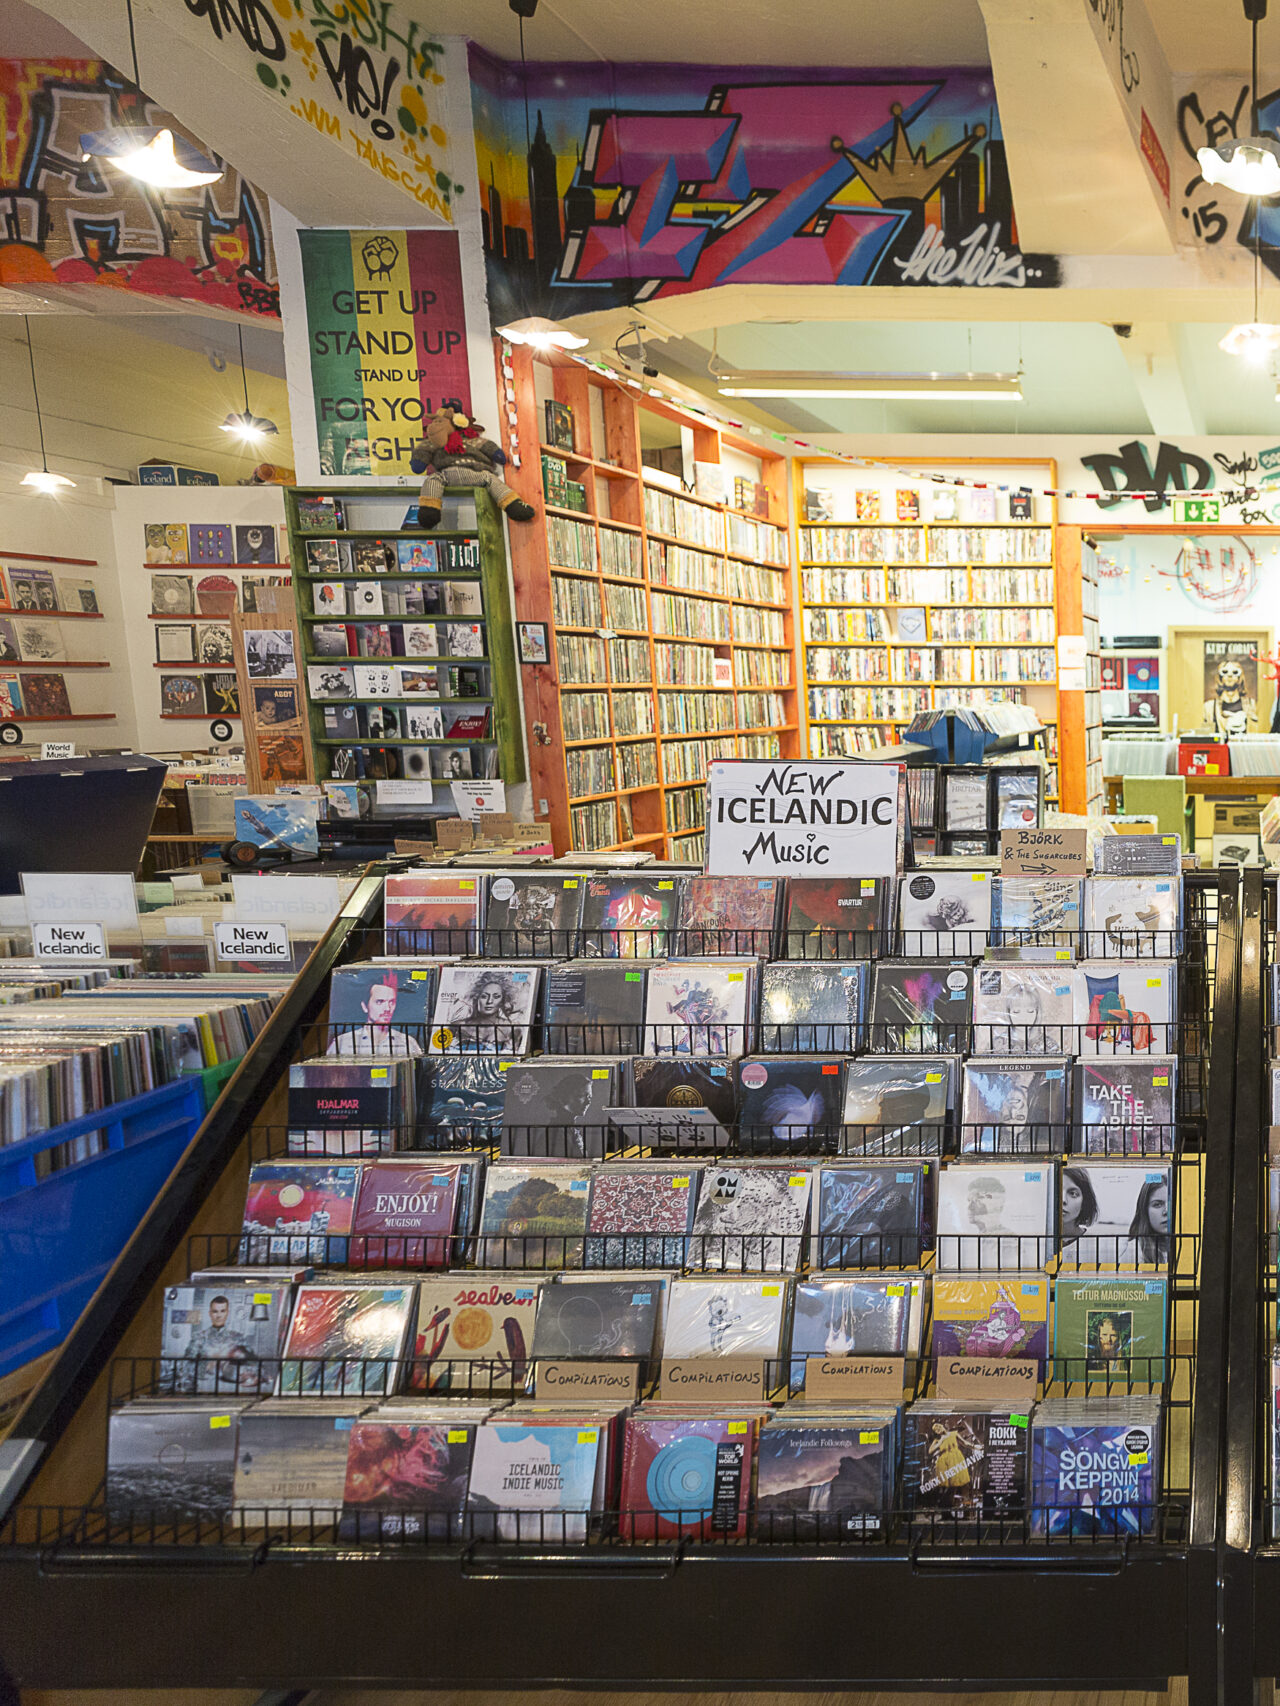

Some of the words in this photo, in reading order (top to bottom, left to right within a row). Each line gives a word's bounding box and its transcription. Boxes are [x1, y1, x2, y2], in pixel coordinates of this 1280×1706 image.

[332, 290, 389, 315] GET
[399, 290, 437, 315] UP
[314, 330, 414, 356] STAND
[423, 331, 461, 355] UP
[354, 369, 403, 382] STAND
[408, 369, 427, 382] UP
[320, 397, 381, 422] FOR
[1080, 440, 1216, 512] DVD
[755, 765, 845, 796] NEW
[717, 797, 893, 826] ICELANDIC
[1017, 831, 1063, 846] BJÖRK
[1004, 847, 1014, 860] &
[51, 928, 85, 940] New
[233, 928, 268, 940] New
[39, 942, 102, 955] Icelandic
[221, 942, 285, 955] Icelandic
[999, 1064, 1032, 1072] LEGEND
[431, 1079, 503, 1089] SHAMELESS
[1090, 1085, 1132, 1100] TAKE
[1110, 1101, 1145, 1116] THE
[1097, 1116, 1154, 1131] ABUSE
[716, 1176, 739, 1188] OM
[714, 1189, 736, 1199] AM
[374, 1193, 439, 1213] ENJOY!
[384, 1218, 422, 1227] MUGISON
[1072, 1289, 1101, 1301] TEITUR
[1101, 1288, 1149, 1301] MAGNÚSSON
[989, 1427, 1017, 1439] ROKK
[789, 1439, 819, 1447] Icelandic
[820, 1439, 853, 1449] Folksongs
[509, 1464, 561, 1476] ICELANDIC
[502, 1477, 530, 1490] INDIE
[534, 1477, 564, 1490] MUSIC
[920, 1477, 941, 1494] ROKK
[1059, 1469, 1139, 1491] KEPPNIN
[1101, 1488, 1139, 1506] 2014
